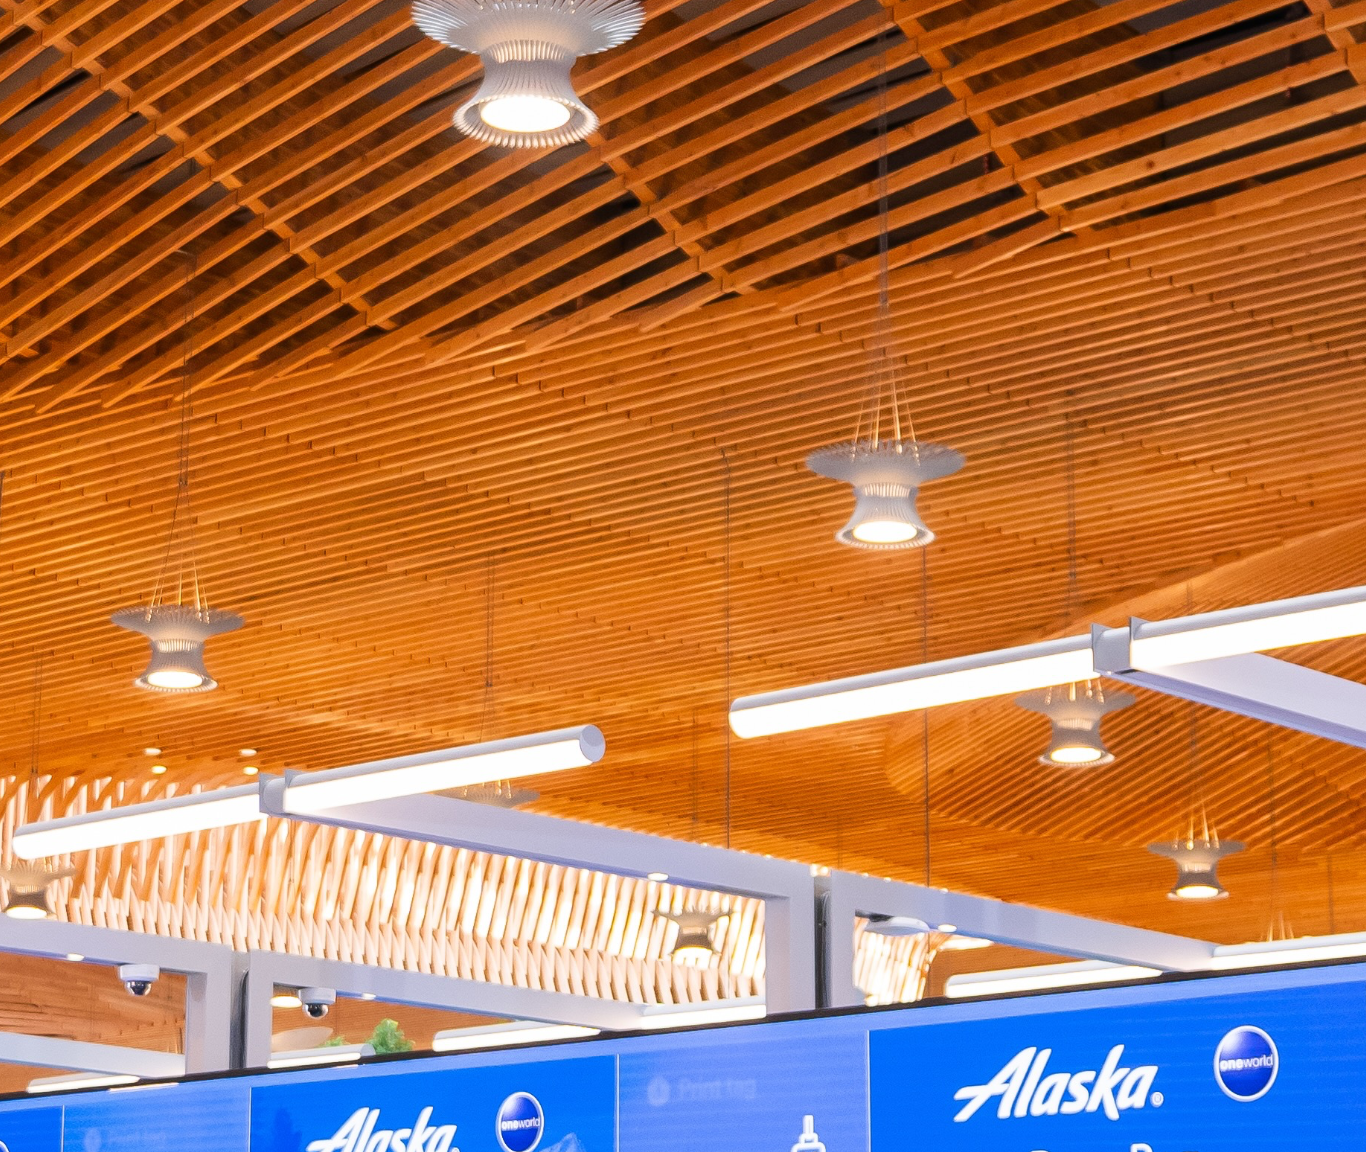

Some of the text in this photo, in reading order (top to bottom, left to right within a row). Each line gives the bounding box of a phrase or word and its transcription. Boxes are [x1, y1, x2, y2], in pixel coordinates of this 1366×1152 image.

[1220, 1054, 1273, 1071] oneworld
[953, 1044, 1158, 1122] Alaska
[501, 1116, 541, 1131] oneworld
